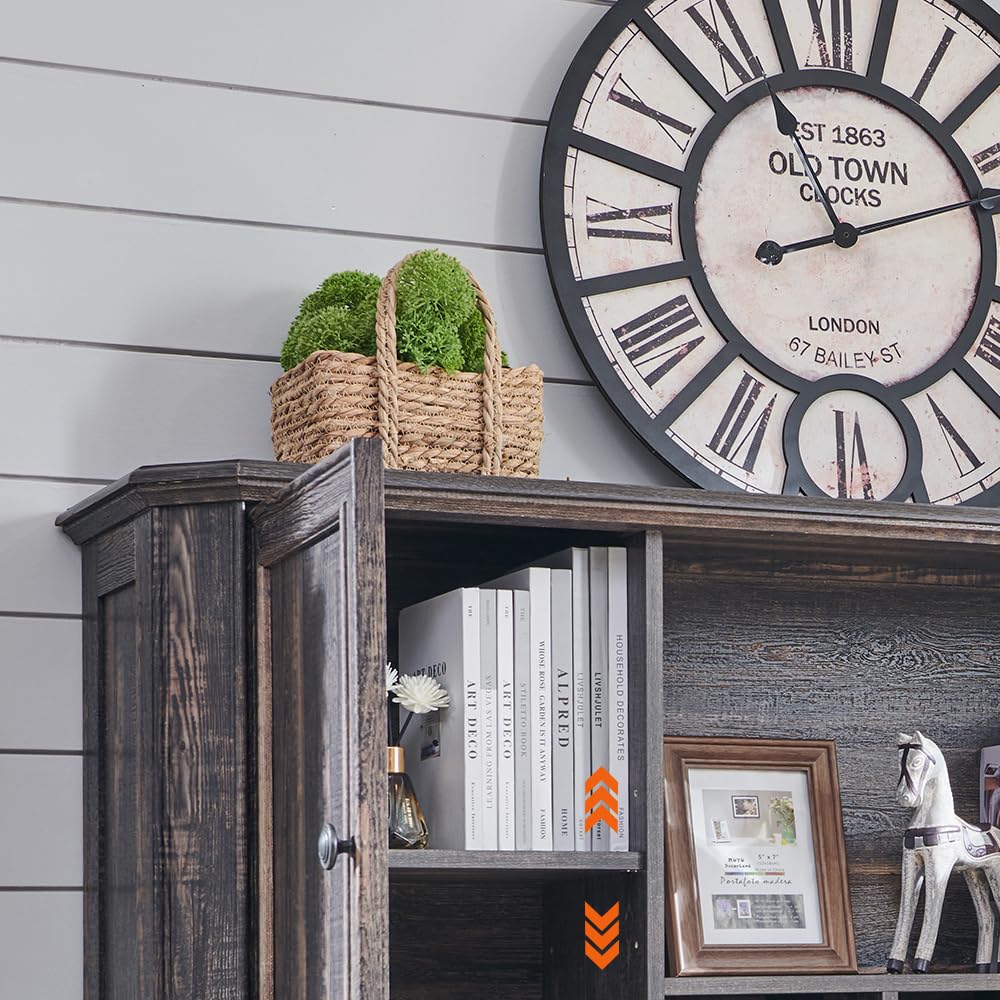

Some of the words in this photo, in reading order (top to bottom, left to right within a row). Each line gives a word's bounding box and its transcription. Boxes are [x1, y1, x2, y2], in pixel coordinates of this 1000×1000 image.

[911, 24, 957, 103] I
[832, 125, 886, 148] 1863
[768, 151, 822, 178] OLD
[828, 156, 908, 186] TOWN
[586, 196, 674, 245] IX
[808, 316, 880, 335] LONDON
[789, 337, 811, 356] 67
[814, 347, 875, 368] BAILEY
[880, 342, 902, 363] ST
[706, 370, 780, 475] VII
[925, 393, 984, 478] V
[832, 409, 876, 500] VI
[428, 661, 447, 678] DECO
[616, 634, 624, 697] HOUSEHOLD
[467, 680, 477, 711] ART
[503, 680, 511, 711] ART
[557, 668, 569, 748] ALPRED
[576, 672, 584, 728] LIVSHJULET
[594, 672, 602, 728] LIVSHJULET
[467, 718, 478, 760] DECO
[503, 718, 512, 760] DECO
[540, 729, 546, 737] IS
[616, 700, 625, 761] DECORATES
